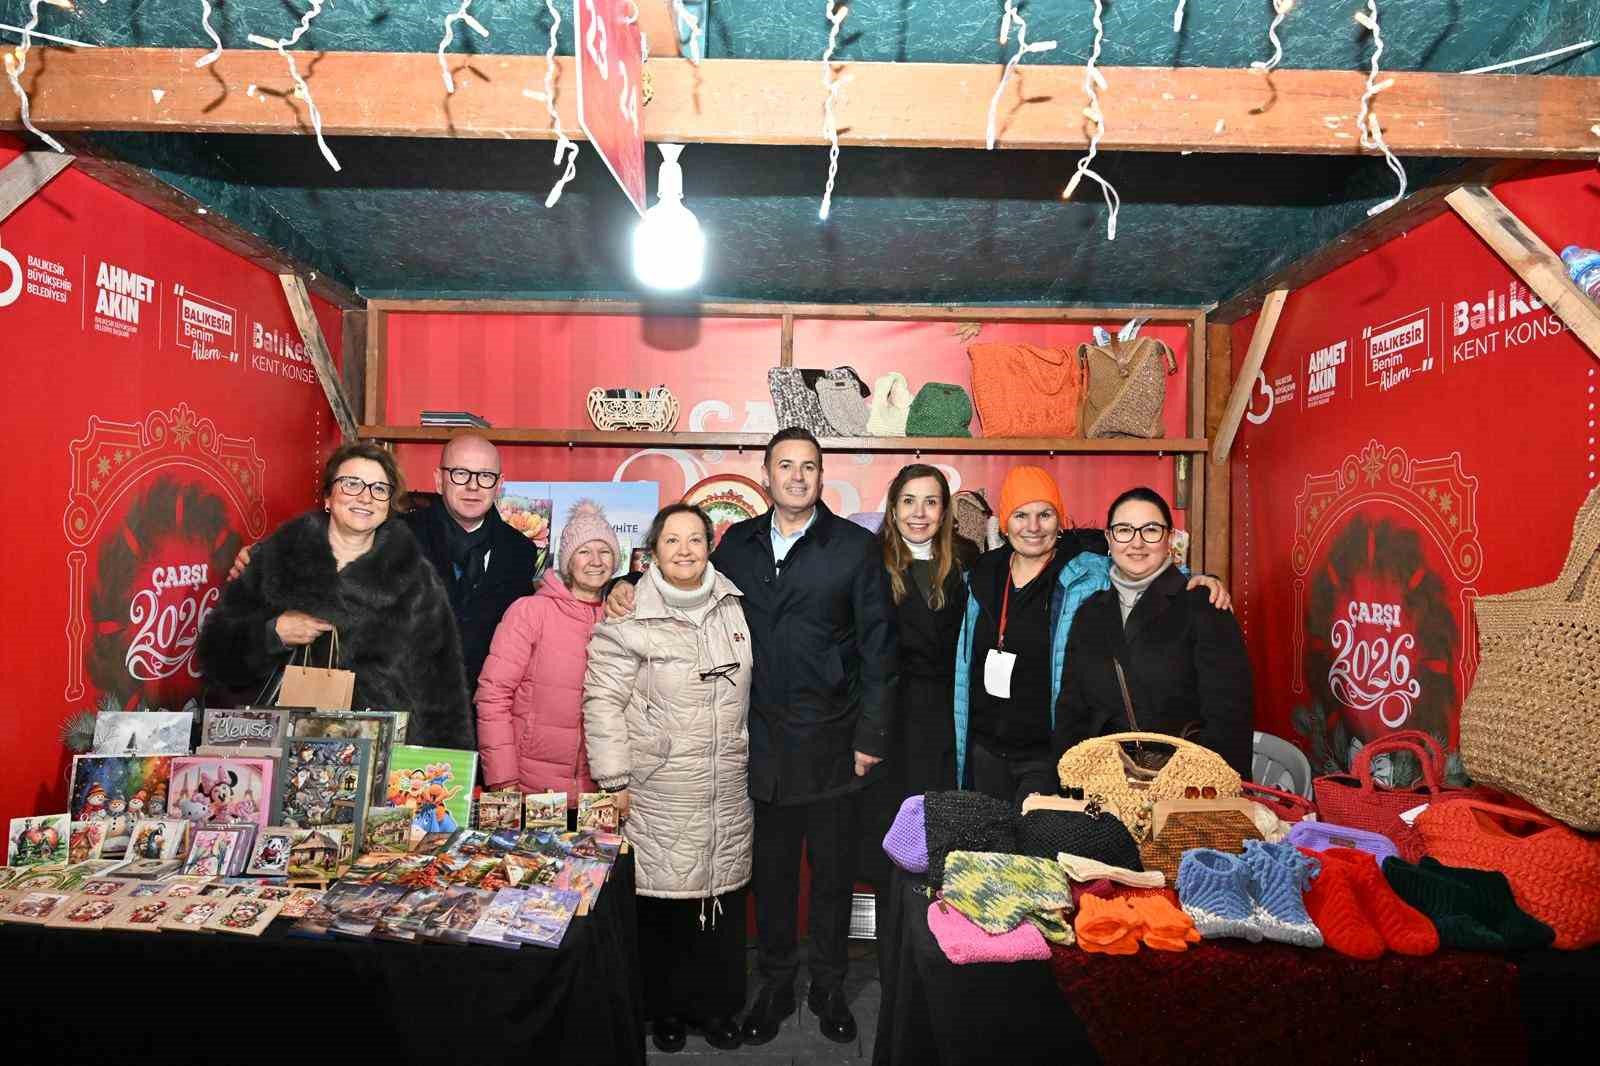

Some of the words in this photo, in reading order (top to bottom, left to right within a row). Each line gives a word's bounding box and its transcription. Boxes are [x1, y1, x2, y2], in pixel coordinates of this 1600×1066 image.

[96, 261, 155, 304] AHMET
[95, 287, 140, 324] AKIN
[184, 306, 231, 333] BALIKESİR
[184, 321, 214, 343] Benim
[1372, 327, 1422, 356] BALIKESİR
[1453, 331, 1500, 363] KENT
[191, 339, 222, 361] Ailem
[252, 353, 280, 376] KENT
[1308, 339, 1347, 375] AHMET
[1372, 353, 1403, 372] Benim
[1308, 366, 1336, 396] AKIN
[1380, 367, 1411, 391] Ailem
[152, 563, 208, 596] ÇARŞI
[1349, 600, 1401, 632] ÇARŞI
[1328, 619, 1420, 715] 2026
